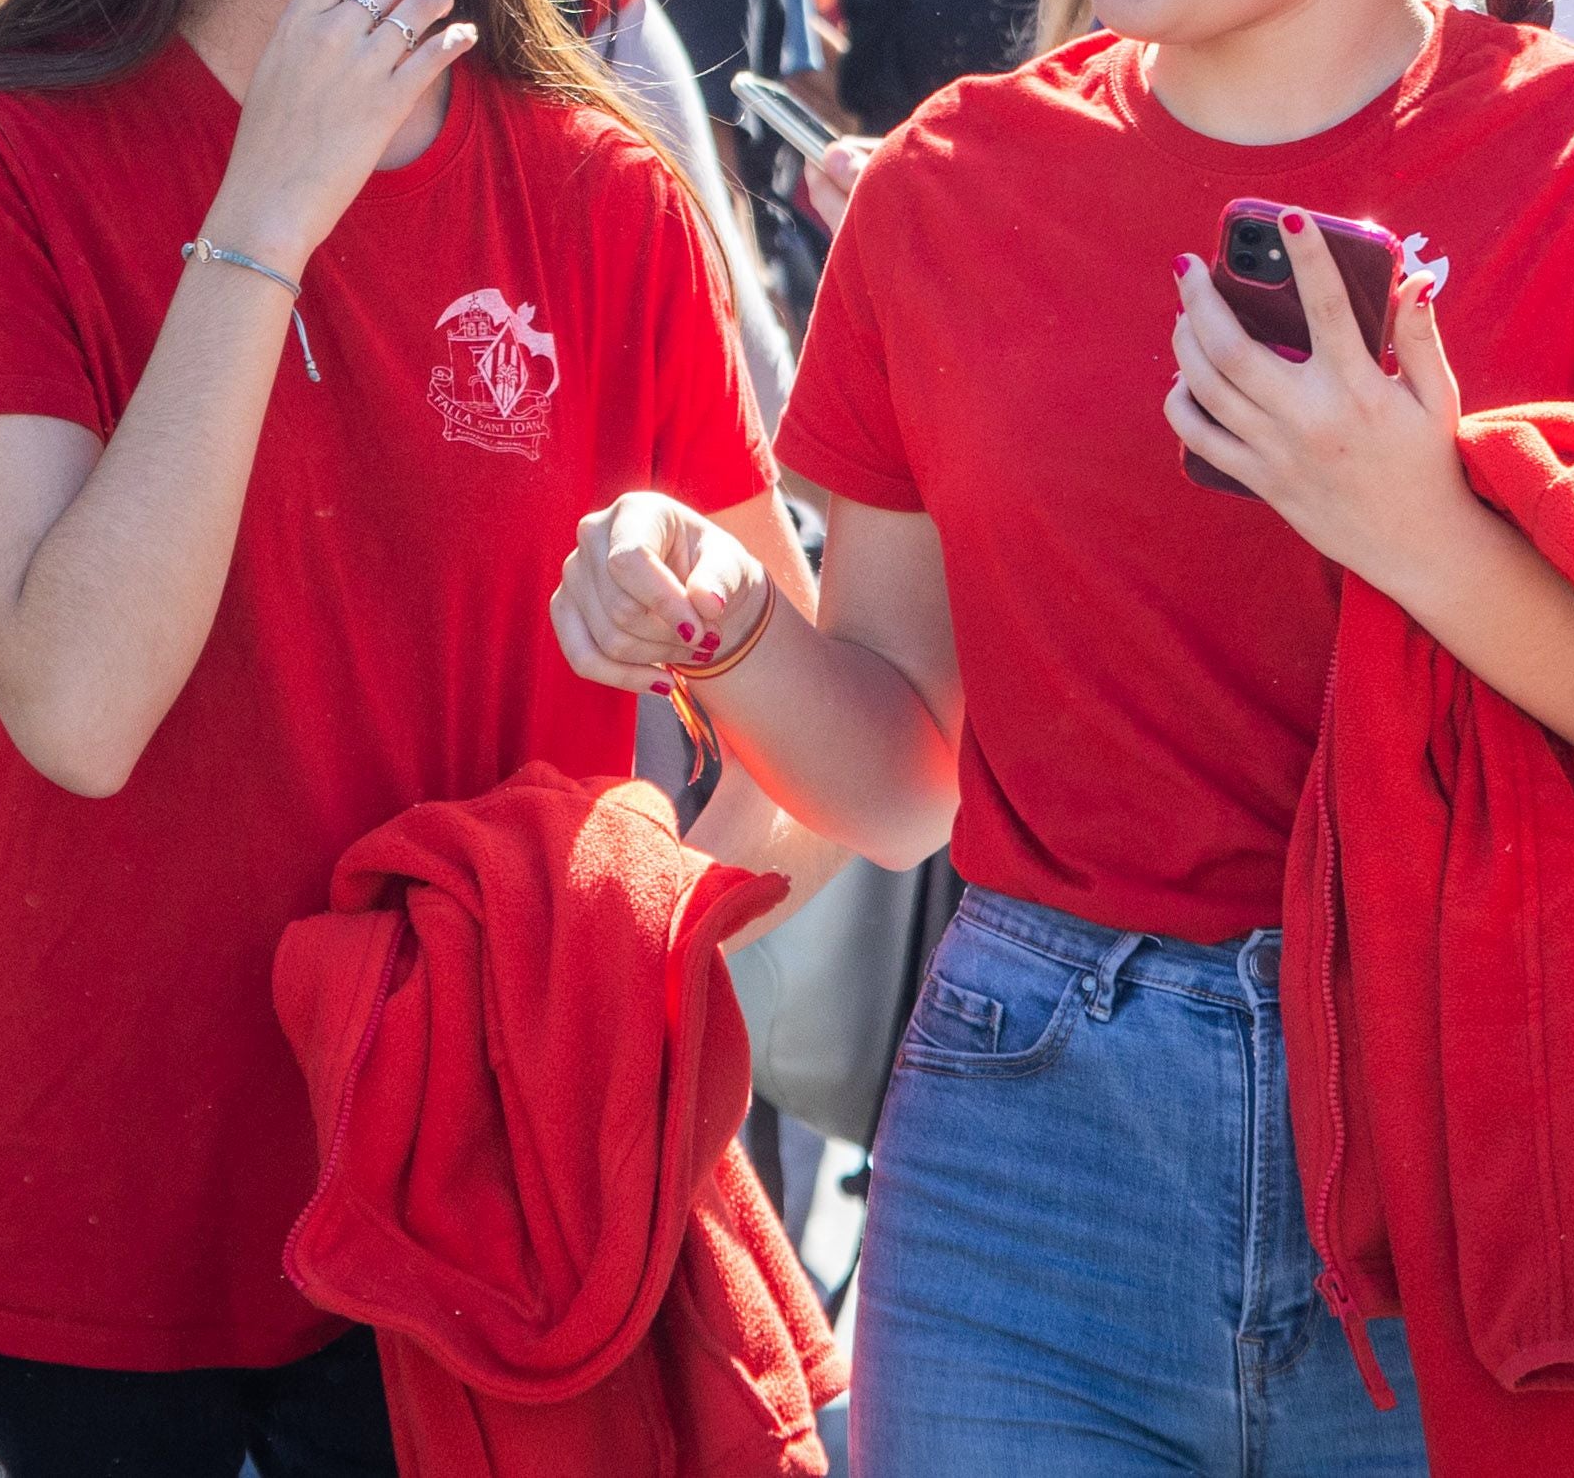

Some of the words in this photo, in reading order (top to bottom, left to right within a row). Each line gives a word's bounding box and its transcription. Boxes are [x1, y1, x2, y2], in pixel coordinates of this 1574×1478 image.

[433, 395, 472, 425] FALLA
[477, 420, 505, 433] SANT
[510, 420, 541, 435] JOAN
